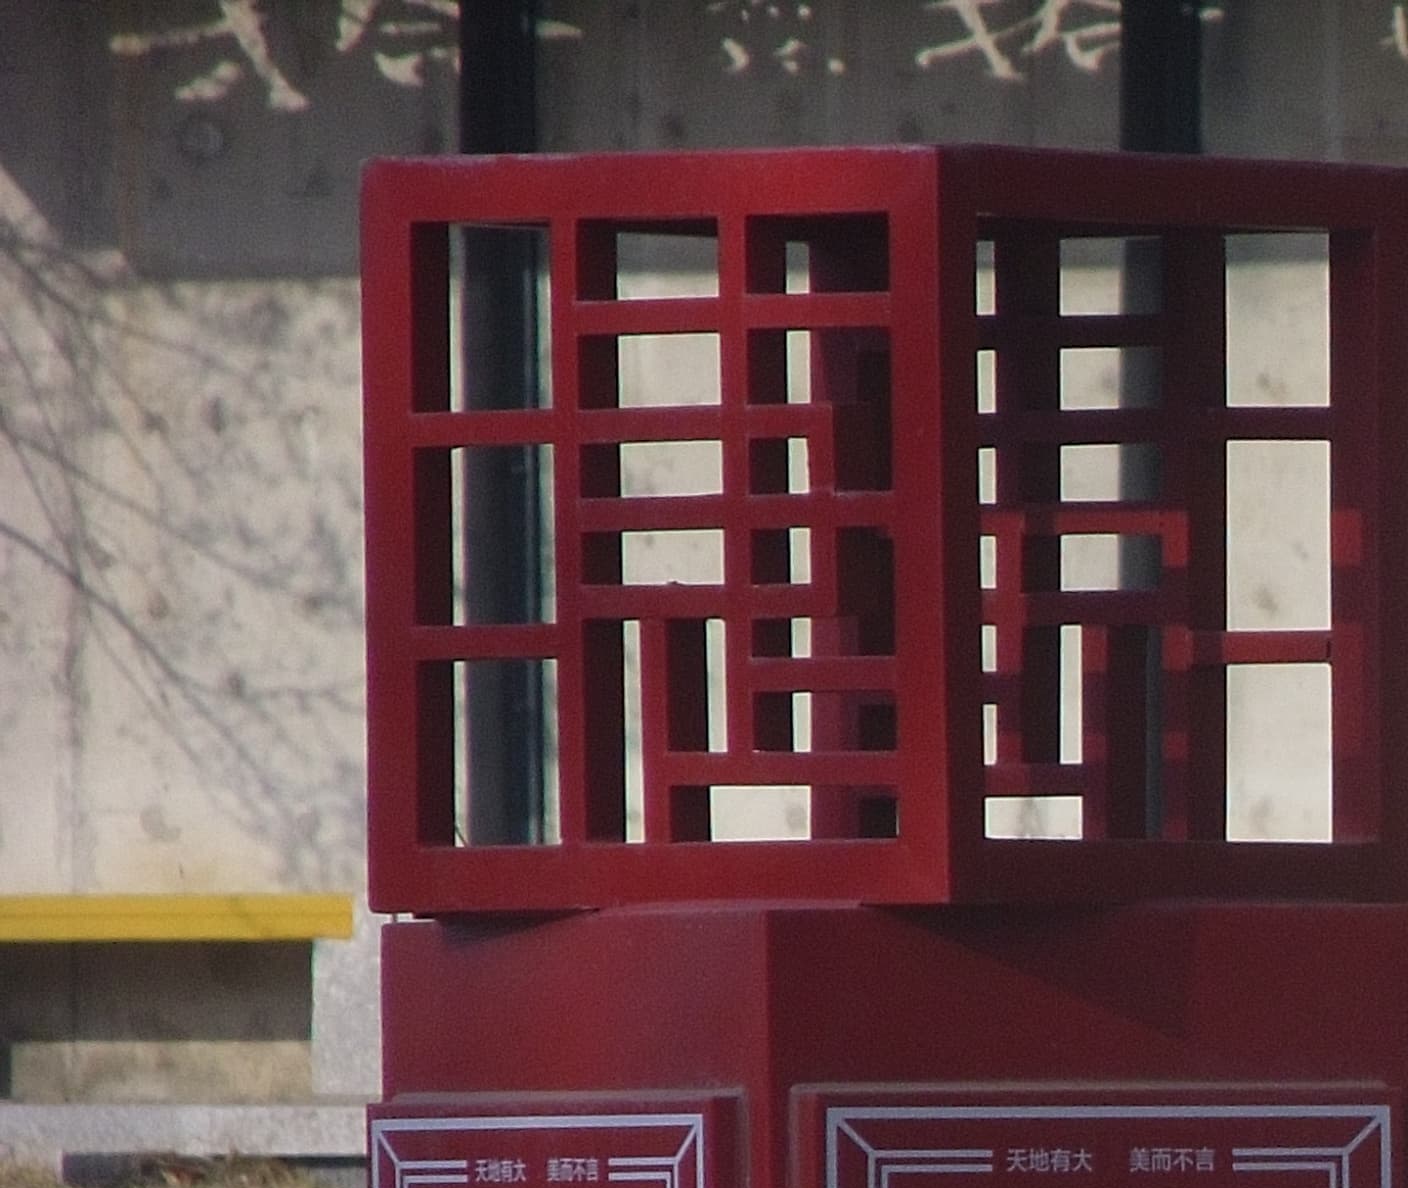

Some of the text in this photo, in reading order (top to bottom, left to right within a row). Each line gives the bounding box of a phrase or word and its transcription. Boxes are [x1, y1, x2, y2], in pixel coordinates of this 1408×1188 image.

[474, 1158, 527, 1183] 天地有大
[1006, 1146, 1216, 1173] 天地有大 美而不言
